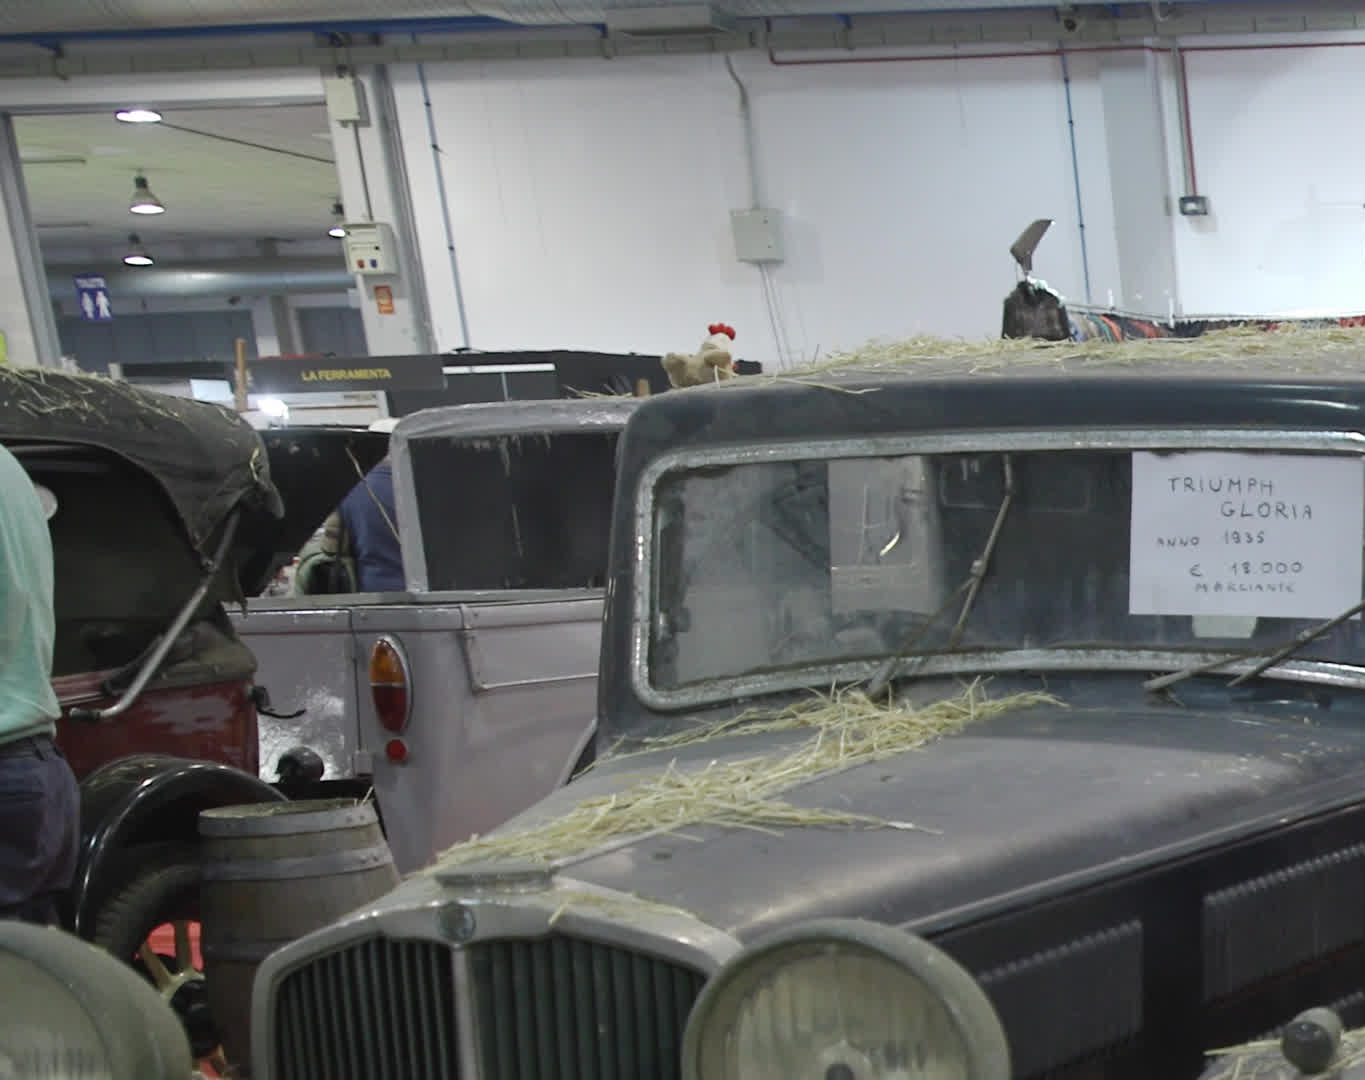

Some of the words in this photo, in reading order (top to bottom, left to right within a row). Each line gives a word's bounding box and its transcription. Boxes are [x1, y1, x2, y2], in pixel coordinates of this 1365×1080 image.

[302, 371, 318, 381] LA
[319, 368, 392, 380] FERRAMENTA
[1168, 477, 1273, 495] TRIUMPH
[1221, 501, 1312, 520] GLORIA
[1156, 537, 1200, 547] ANNO
[1190, 564, 1202, 577] €
